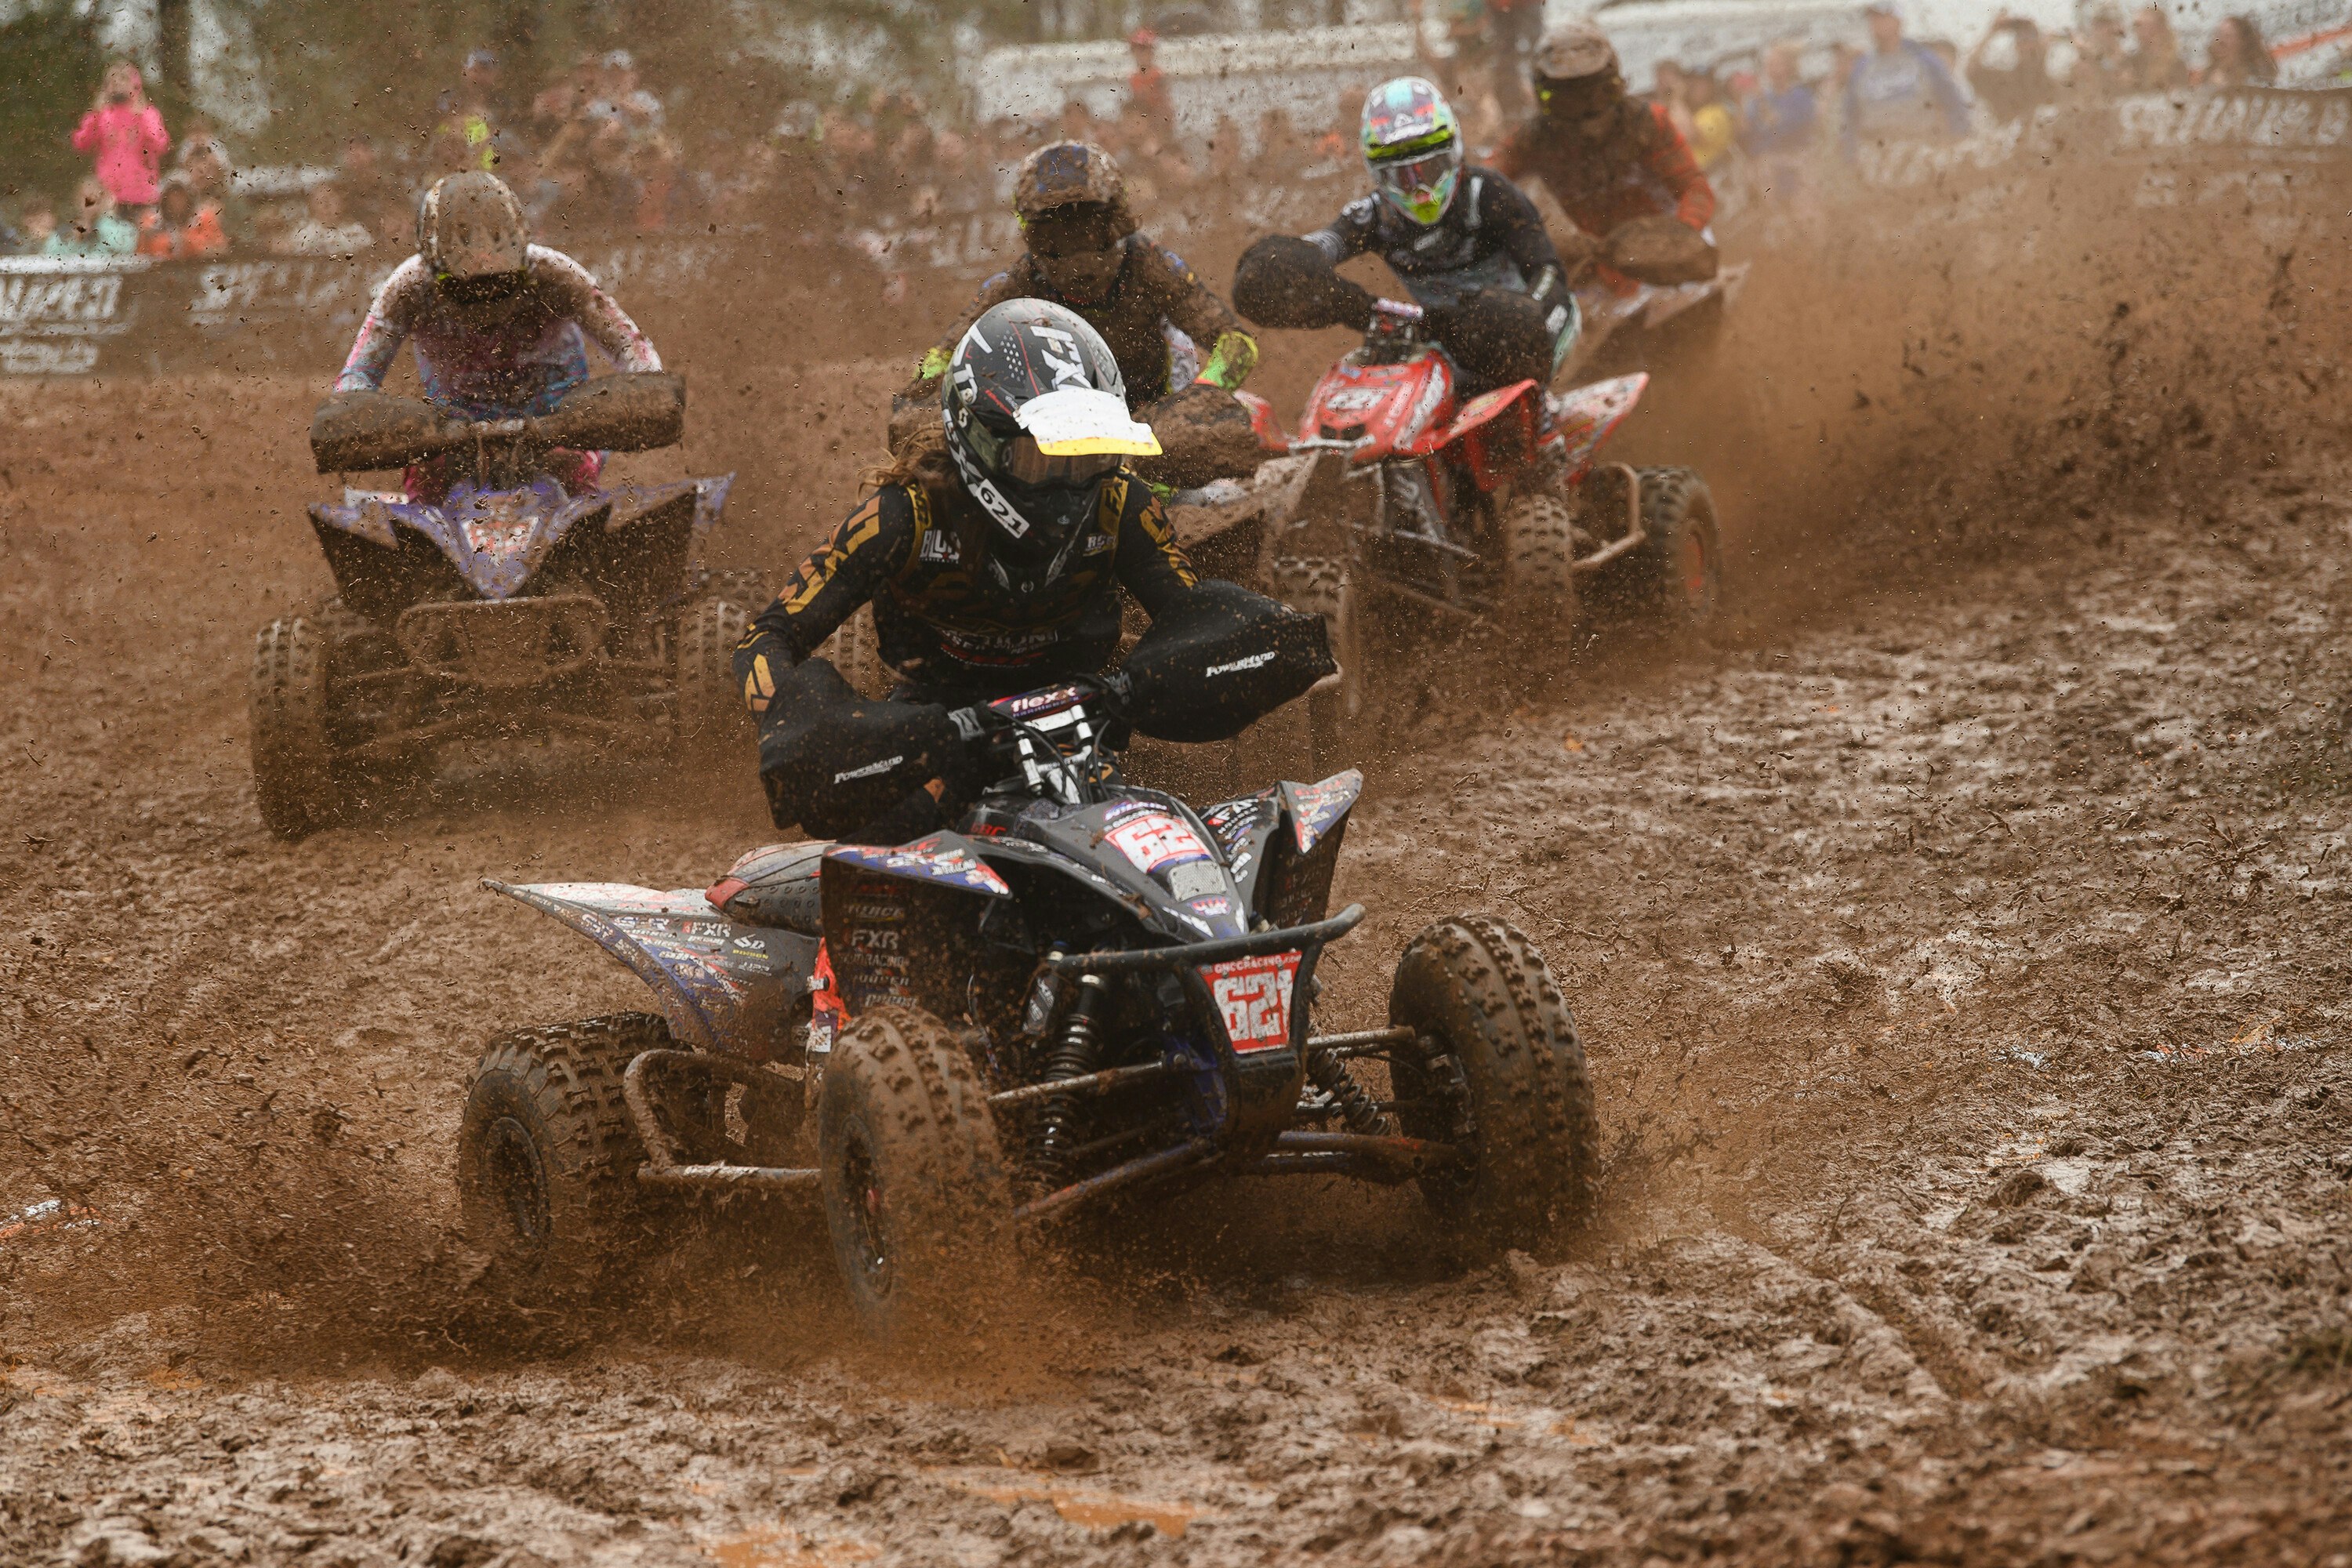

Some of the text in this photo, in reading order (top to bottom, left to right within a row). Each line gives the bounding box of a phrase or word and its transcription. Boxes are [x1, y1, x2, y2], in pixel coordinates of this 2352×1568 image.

[1029, 325, 1094, 392] FX
[942, 407, 985, 498] FX
[980, 485, 1022, 535] 621
[690, 921, 731, 938] FXR
[851, 928, 900, 950] FXR
[1213, 968, 1294, 1042] 621
